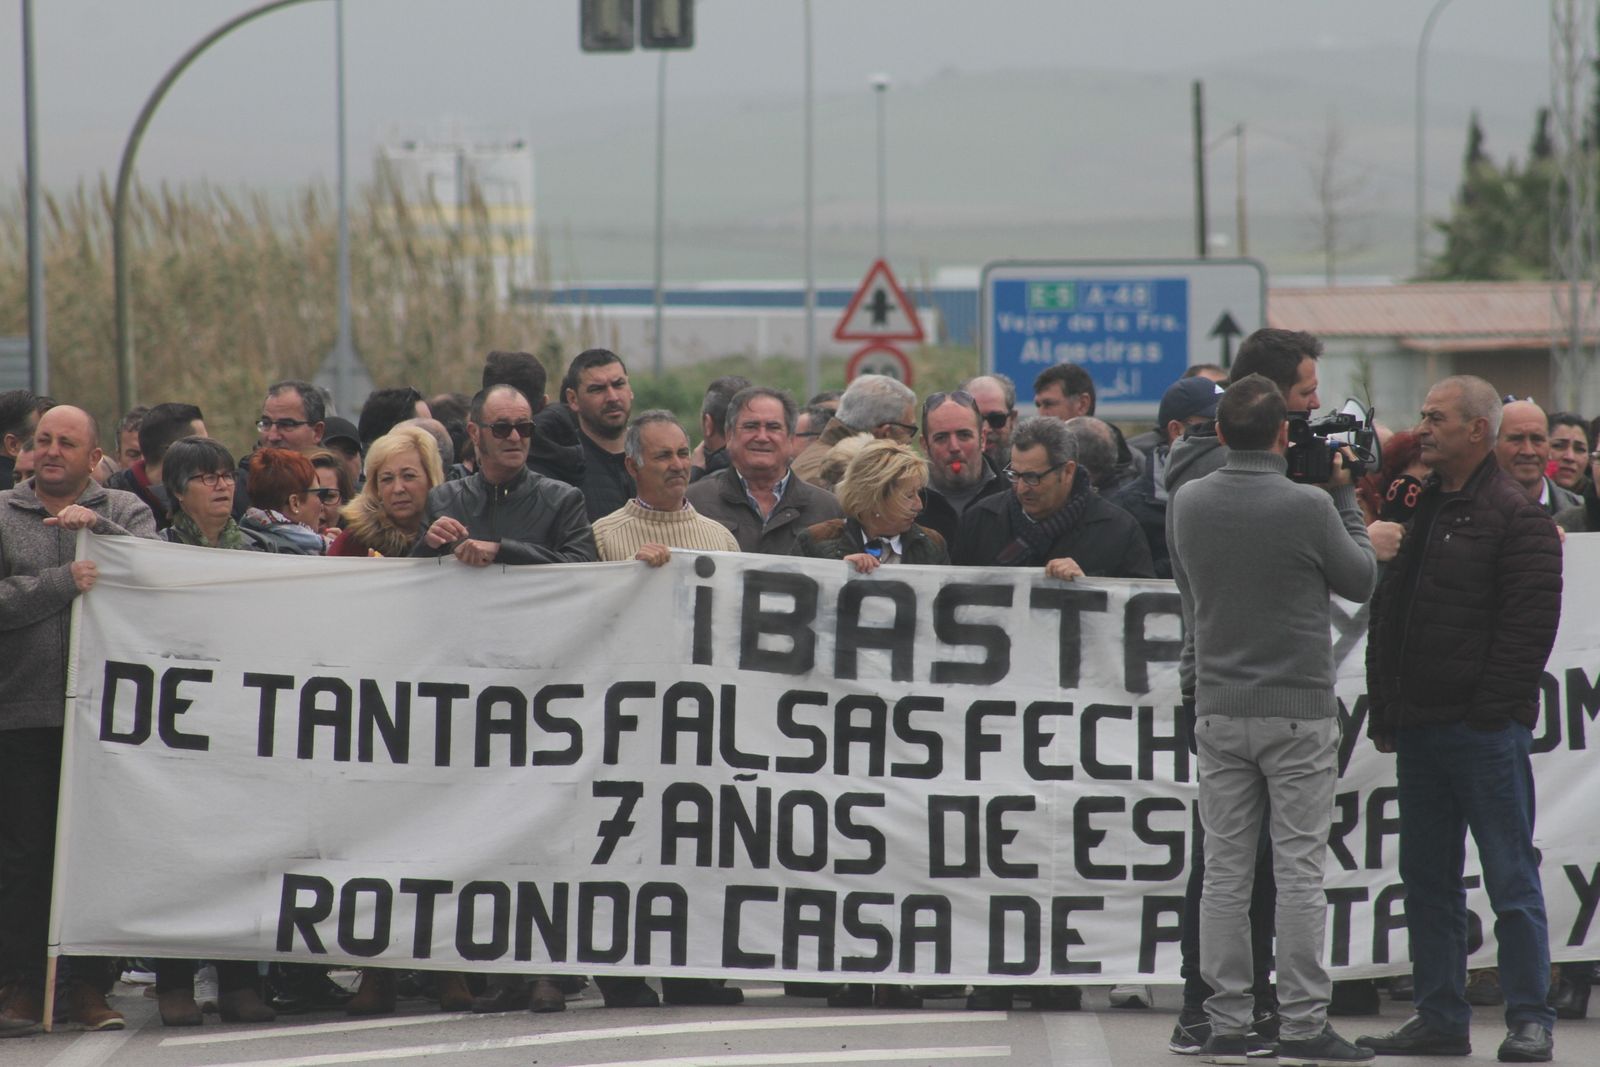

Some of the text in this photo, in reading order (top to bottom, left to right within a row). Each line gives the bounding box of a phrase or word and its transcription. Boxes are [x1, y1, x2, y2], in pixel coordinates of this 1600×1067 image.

[998, 313, 1058, 336] Vejer
[1067, 313, 1096, 332] de
[1104, 312, 1129, 332] la
[1021, 338, 1162, 363] Algeciras
[100, 660, 213, 752] DE
[243, 671, 585, 768] TANTAS
[603, 681, 945, 780] FALSAS
[964, 700, 1190, 783] FECH
[591, 772, 1401, 882] 7 AÑOS DE ESRA
[276, 873, 688, 967] ROTONDA
[722, 884, 953, 975] CASA
[988, 894, 1105, 976] DE
